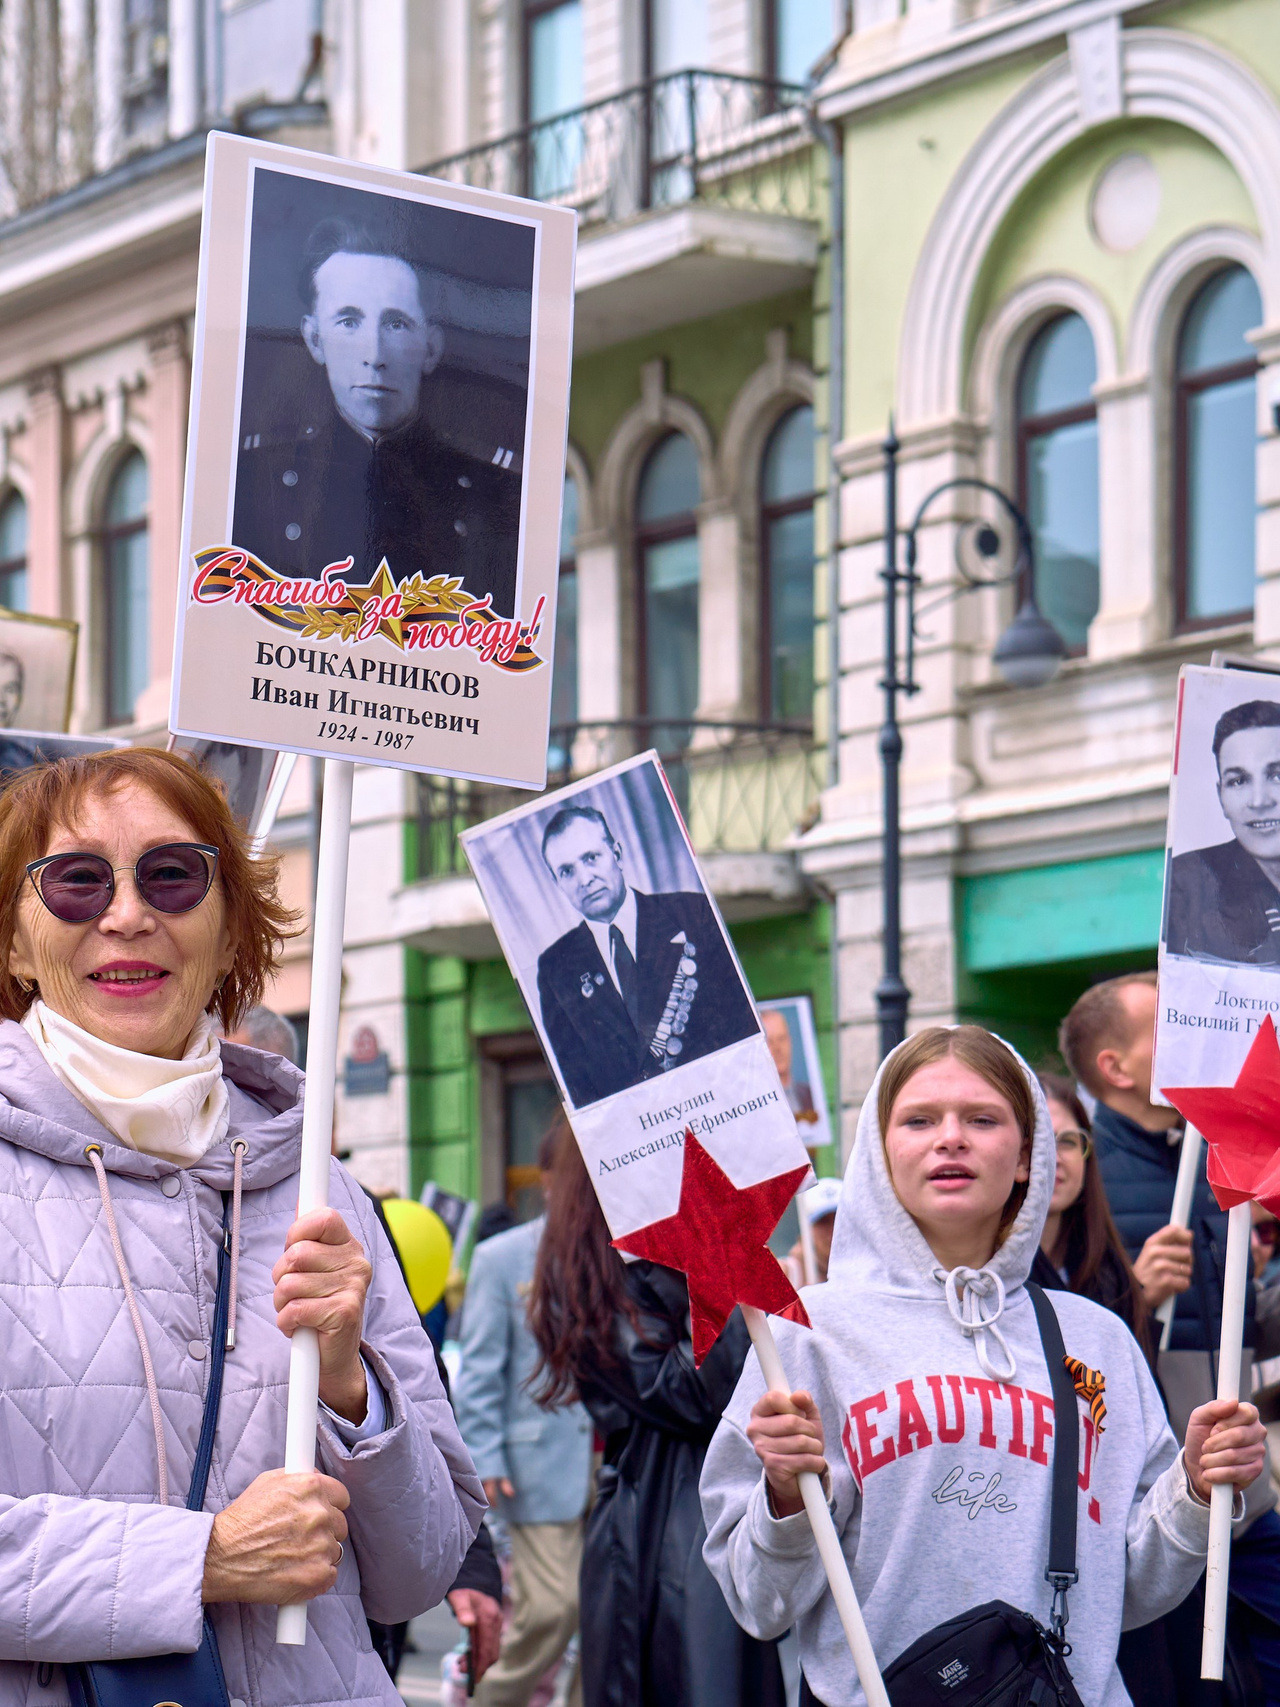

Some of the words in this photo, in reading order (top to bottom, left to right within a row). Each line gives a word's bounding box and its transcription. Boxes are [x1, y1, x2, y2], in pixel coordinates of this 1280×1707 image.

[193, 551, 352, 603] Спасибо
[357, 593, 404, 641] за
[408, 596, 546, 663] победу!
[255, 641, 480, 699] БОЧКАРНИКОВ
[250, 677, 320, 710] Иван
[326, 689, 480, 735] Игнатьевич
[317, 721, 358, 743] 1924
[373, 730, 415, 750] 1987
[1166, 1008, 1240, 1033] Василий
[1214, 990, 1280, 1013] Локтио
[598, 1129, 685, 1176] Александр
[688, 1090, 780, 1136] Ефимович
[638, 1090, 715, 1130] Никулин
[841, 1374, 1101, 1525] EAUTIF
[932, 1466, 1018, 1520] life
[937, 1659, 962, 1680] VANS
